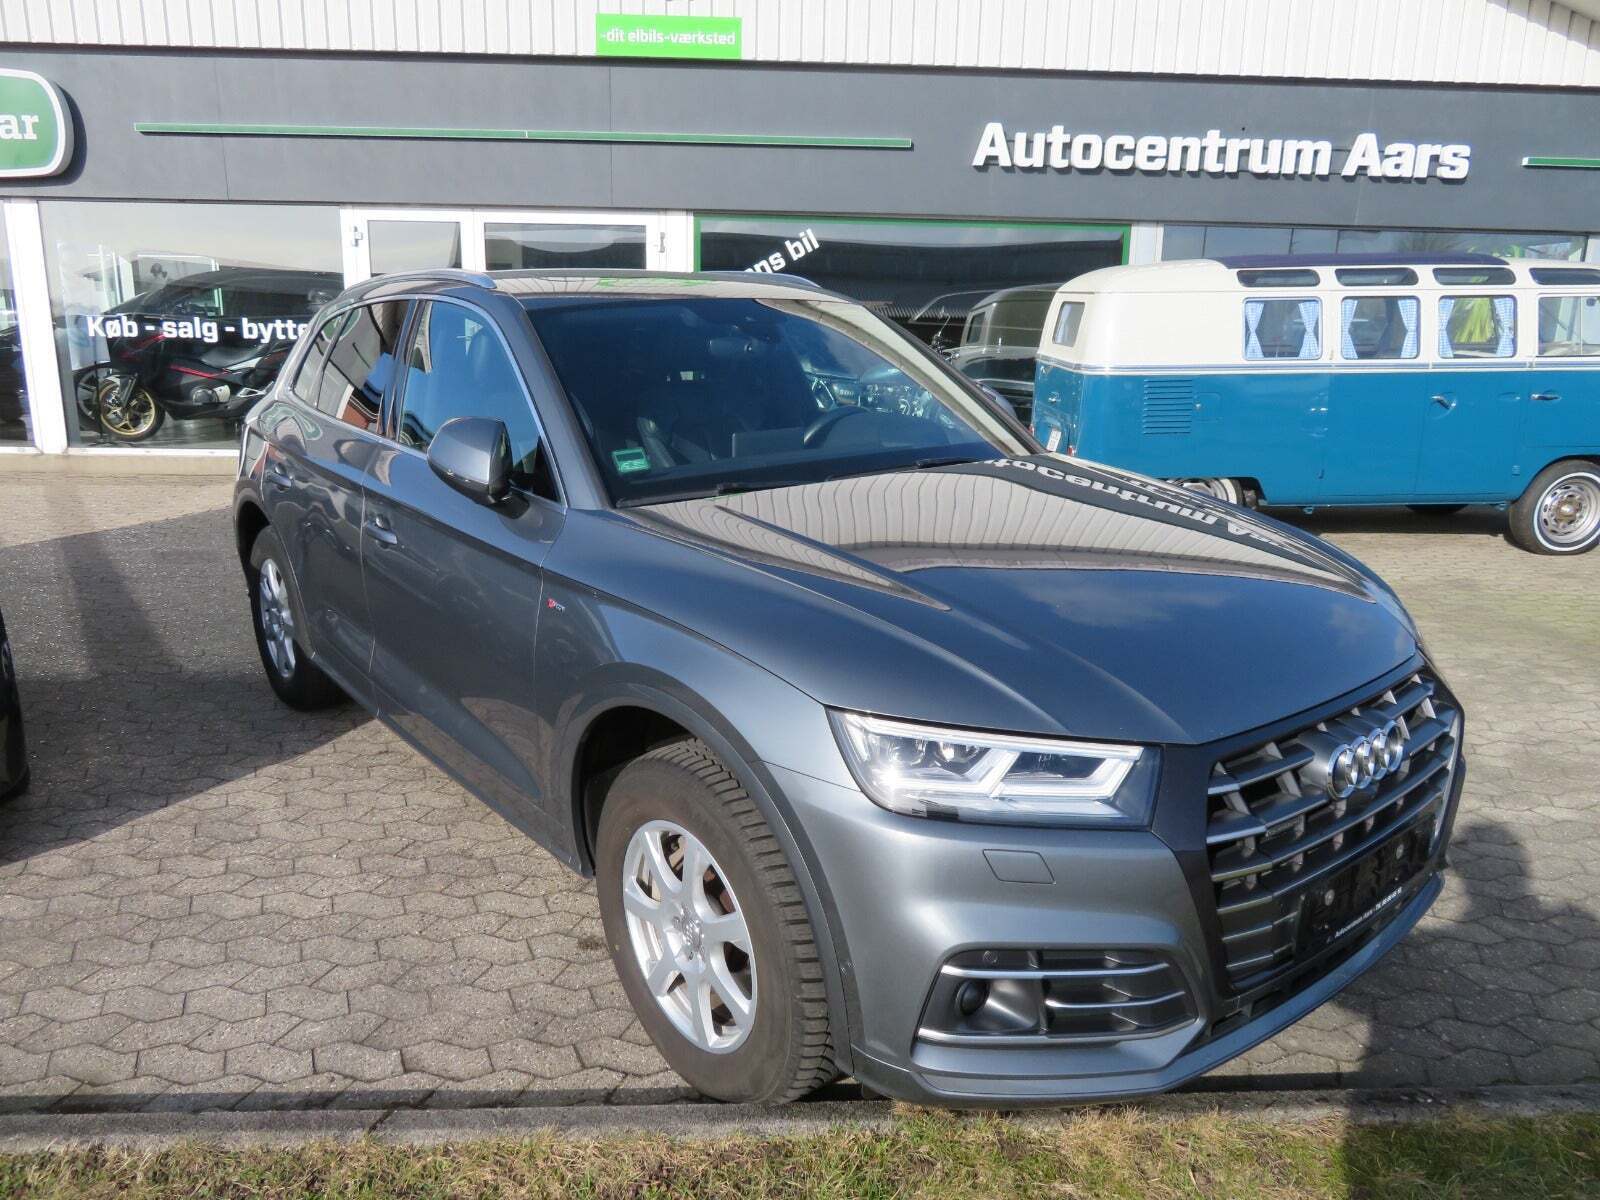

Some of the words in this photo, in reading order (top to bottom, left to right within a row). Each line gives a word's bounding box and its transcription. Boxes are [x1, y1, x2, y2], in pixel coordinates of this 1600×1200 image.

[602, 28, 625, 42] -dit
[627, 28, 736, 45] elbils-værksted
[0, 114, 39, 140] ar
[972, 122, 1332, 176] Autocentrum
[1341, 132, 1471, 179] Aars
[744, 251, 786, 274] ns
[784, 228, 820, 261] bil
[86, 314, 139, 339] Køb
[162, 316, 219, 343] salg
